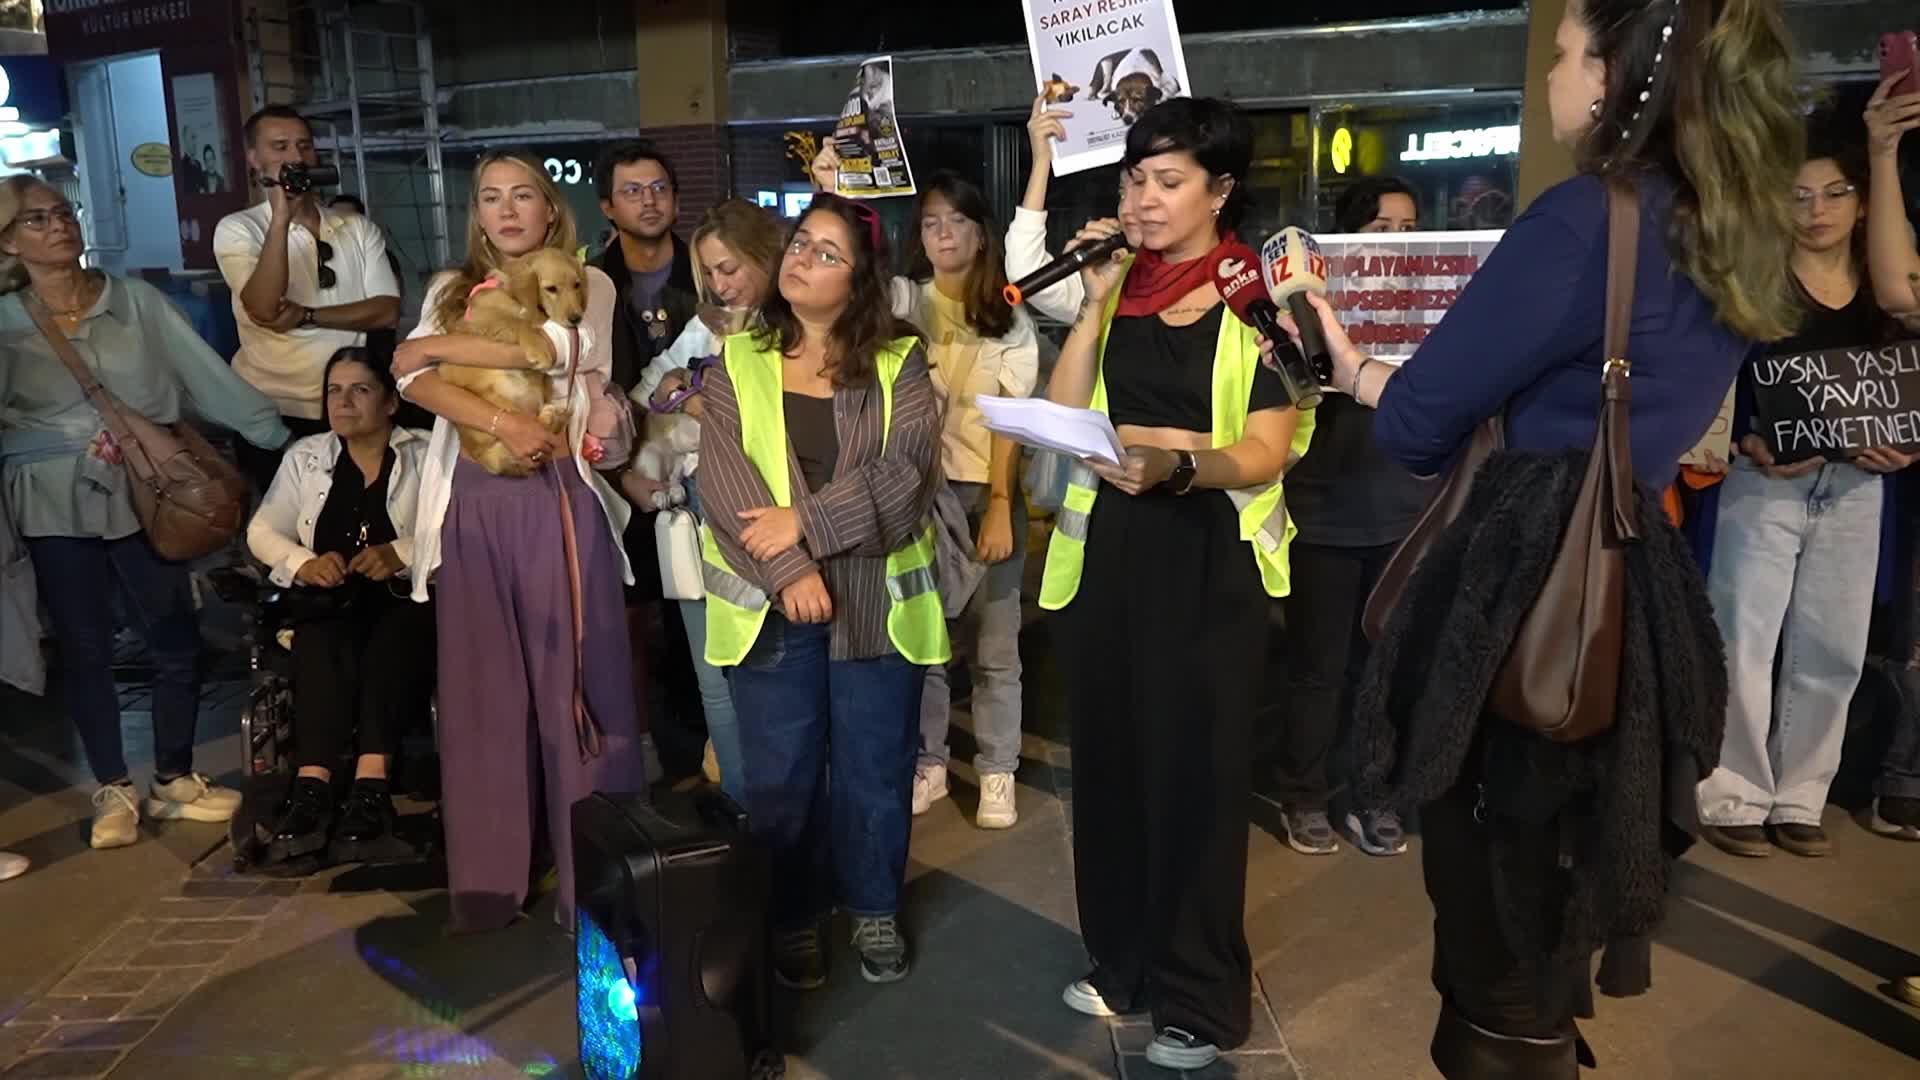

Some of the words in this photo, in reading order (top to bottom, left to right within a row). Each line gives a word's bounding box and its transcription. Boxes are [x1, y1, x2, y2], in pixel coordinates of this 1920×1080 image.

[1039, 4, 1093, 30] SARAY
[1055, 13, 1145, 48] YIKILACAK
[1222, 269, 1257, 295] anka
[1753, 355, 1841, 385] UYSAL
[1797, 379, 1900, 412] YAVRU
